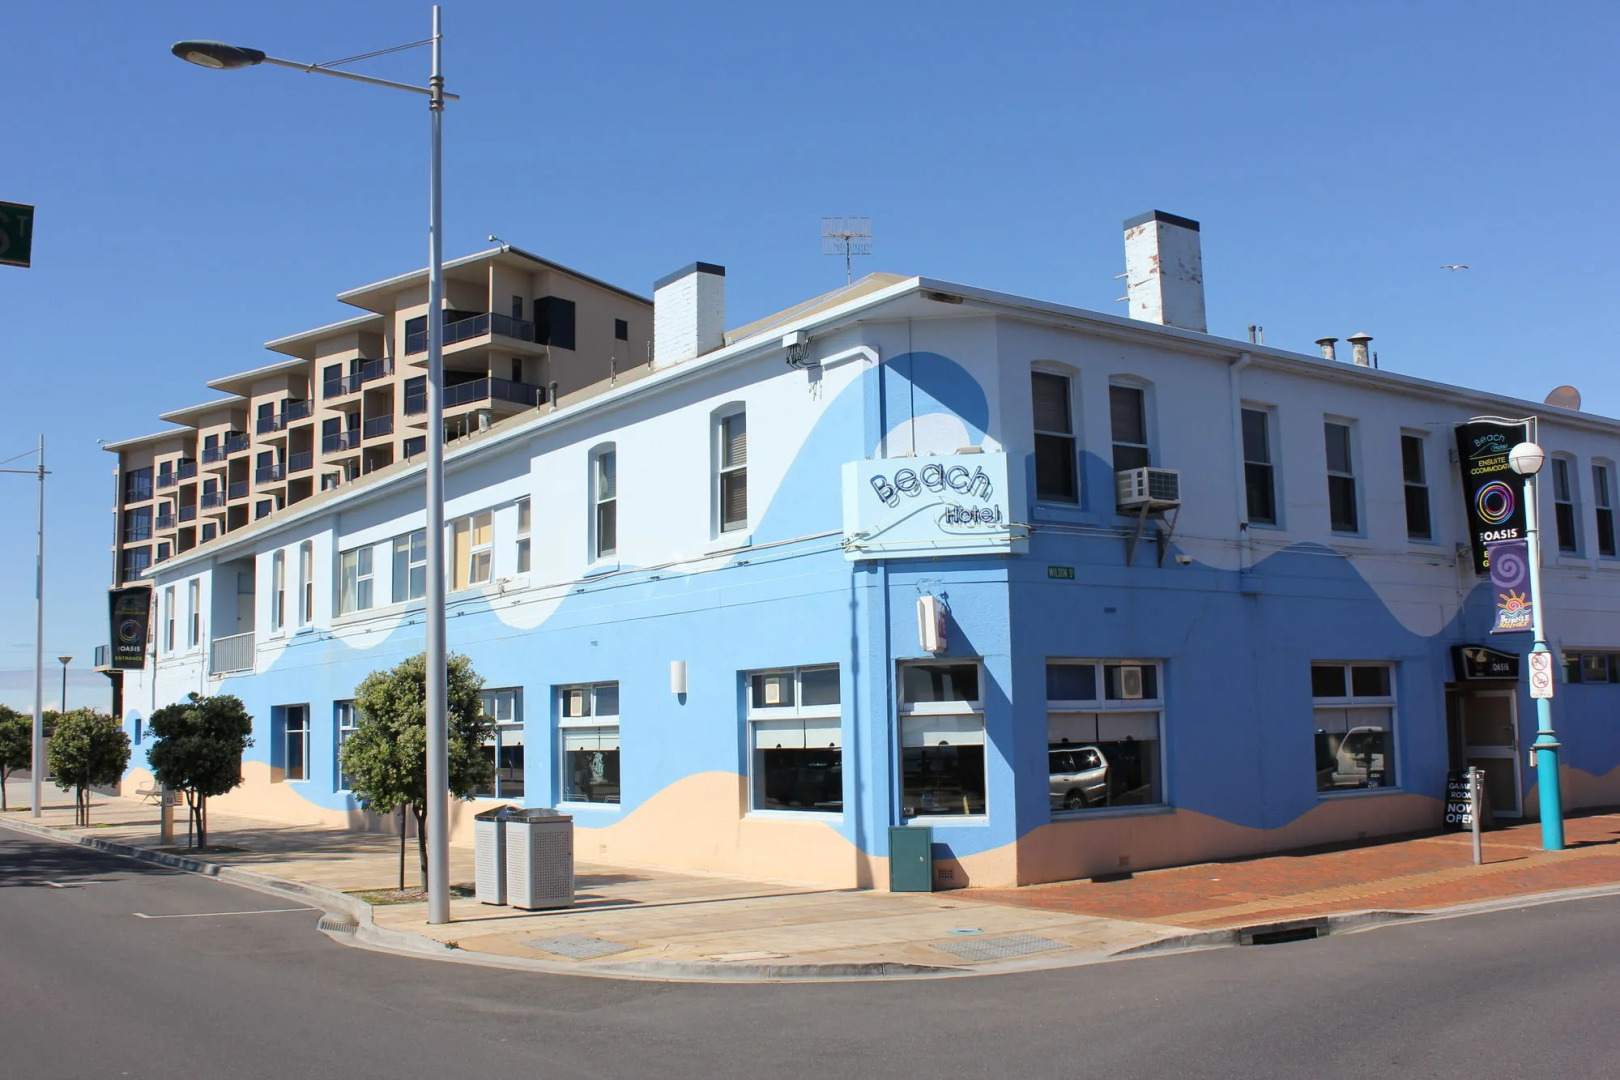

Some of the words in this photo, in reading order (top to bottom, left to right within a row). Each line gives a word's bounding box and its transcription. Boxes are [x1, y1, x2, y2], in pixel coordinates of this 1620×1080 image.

[1474, 433, 1506, 447] Beach
[1478, 456, 1506, 467] ENSUITE
[1470, 463, 1510, 475] CCOMMODATI
[869, 463, 991, 505] Beach
[945, 503, 1001, 524] Hotel
[1484, 528, 1518, 541] OASIS
[1492, 663, 1510, 671] OASIS
